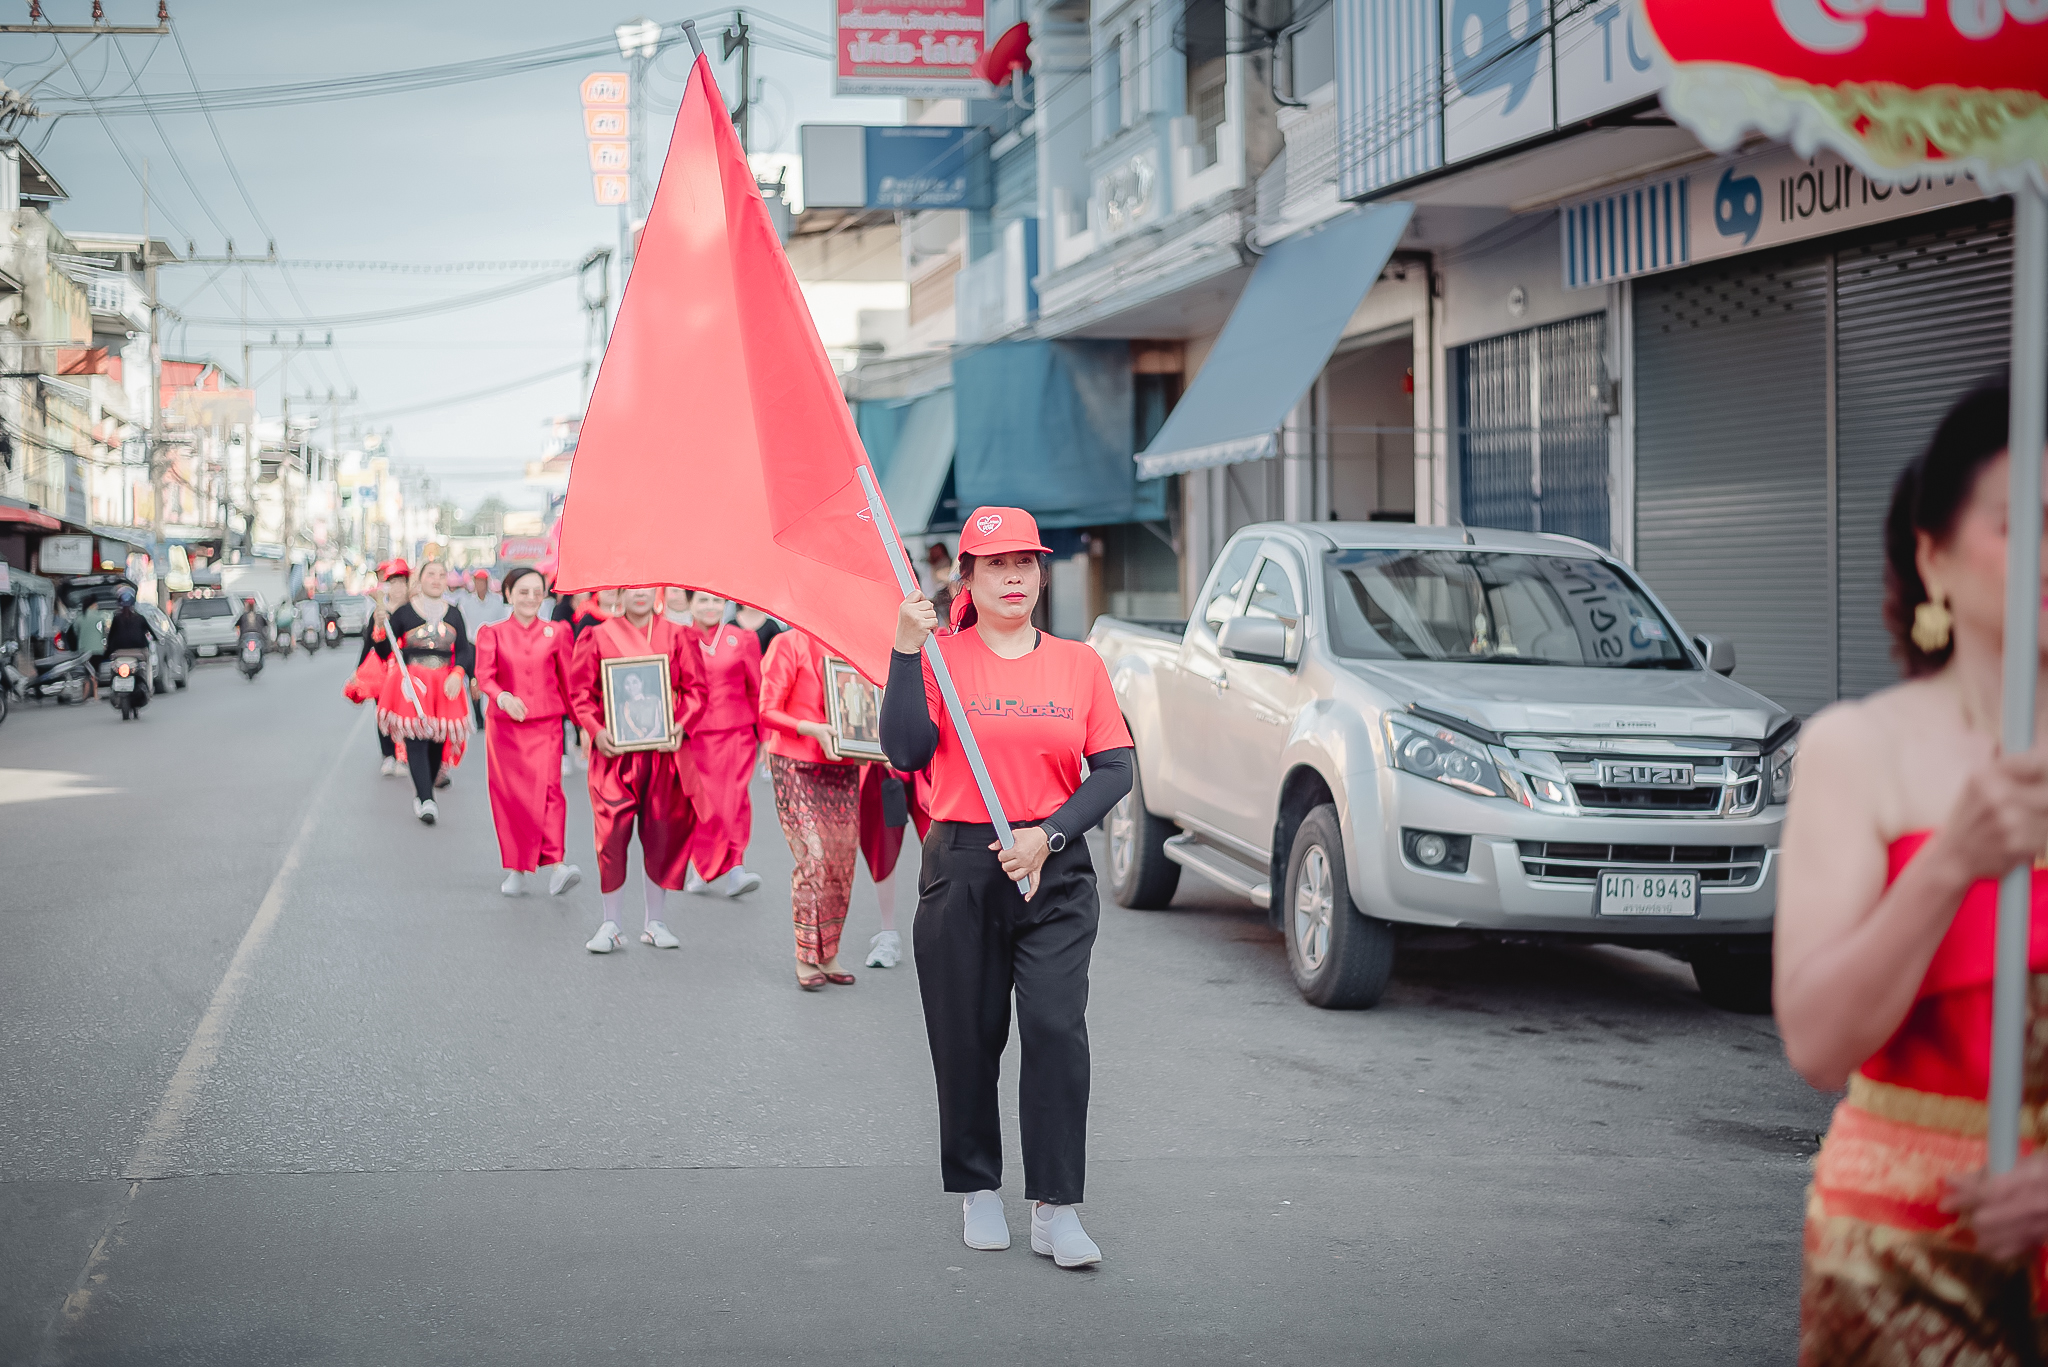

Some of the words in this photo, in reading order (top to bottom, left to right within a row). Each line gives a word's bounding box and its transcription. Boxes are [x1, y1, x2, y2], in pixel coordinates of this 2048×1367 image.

[962, 693, 1024, 716] AIR
[1604, 766, 1690, 784] ISUZU
[1643, 878, 1692, 899] 8943
